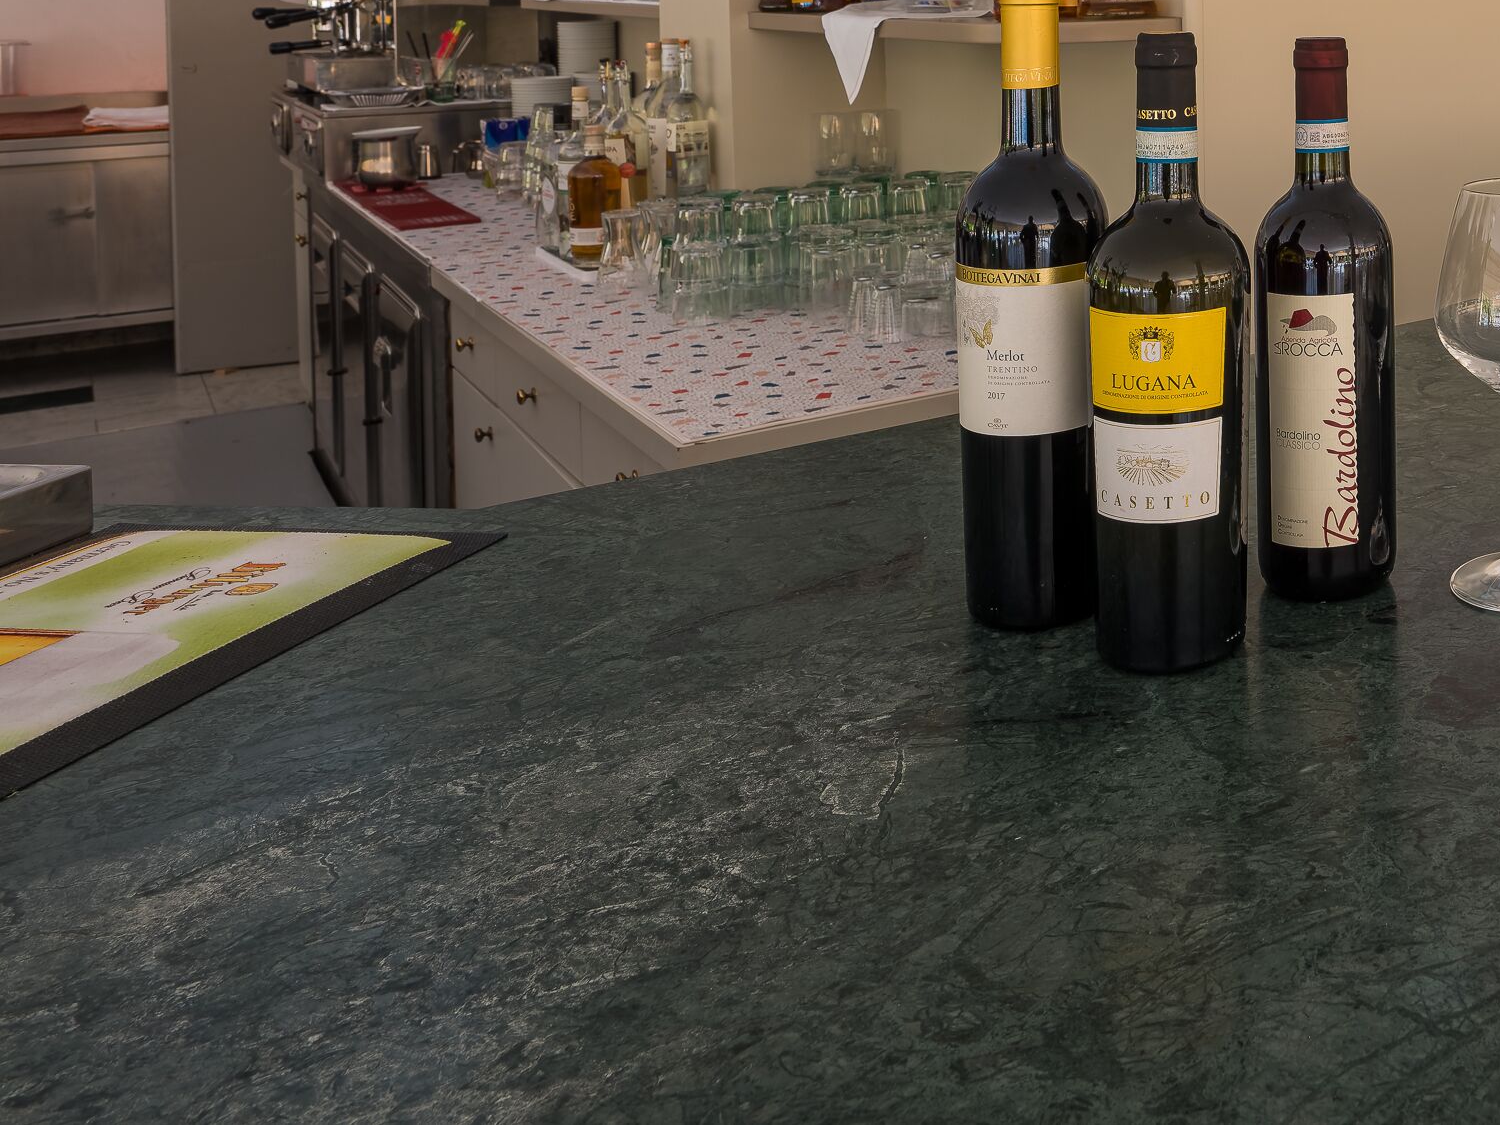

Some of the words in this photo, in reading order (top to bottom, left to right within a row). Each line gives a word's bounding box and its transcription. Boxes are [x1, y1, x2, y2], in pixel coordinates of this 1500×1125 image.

[1137, 109, 1177, 120] ASETTO
[962, 268, 1001, 284] BOTTEGA
[1002, 272, 1041, 284] VINAI
[1308, 336, 1338, 345] Agricola
[986, 349, 1025, 362] Merlot
[986, 365, 1038, 374] TRENTINO
[1111, 372, 1197, 391] LUGANA
[987, 391, 1006, 401] 2017
[1102, 390, 1140, 400] DENOMINAZIONE
[1170, 390, 1209, 400] CONTROLLATA
[1276, 428, 1321, 441] Bardolino
[1276, 439, 1321, 451] CLASSICO
[1322, 366, 1359, 548] Bardolino
[1101, 489, 1210, 510] CASETTO
